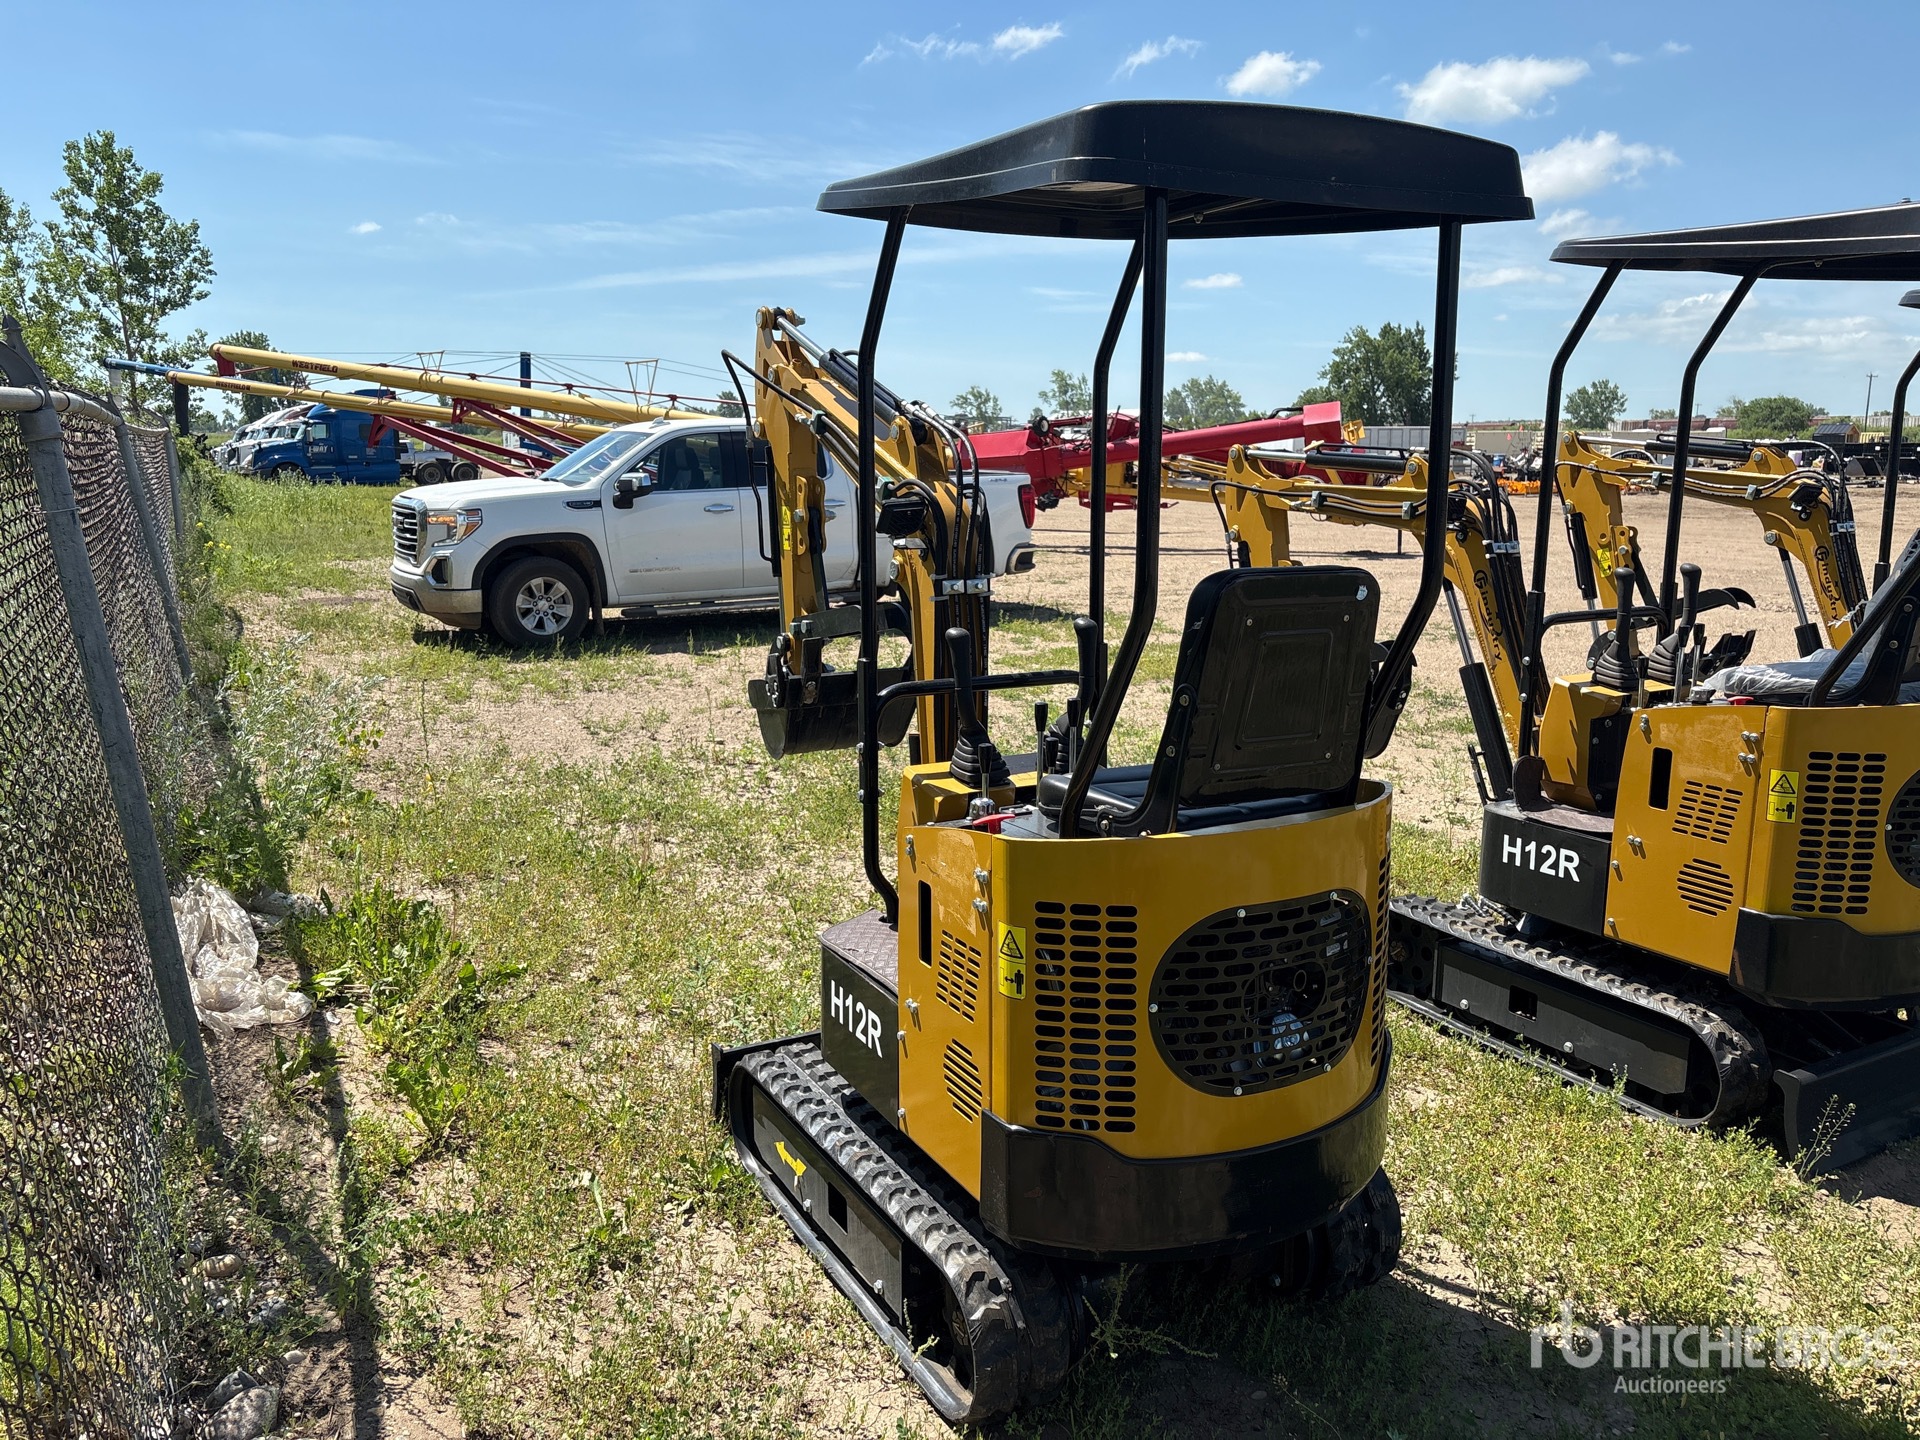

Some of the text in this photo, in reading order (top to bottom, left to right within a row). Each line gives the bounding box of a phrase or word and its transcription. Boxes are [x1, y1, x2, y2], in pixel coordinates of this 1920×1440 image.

[292, 360, 338, 373] WESTFIELD
[215, 380, 246, 391] WESTFIELD
[1502, 833, 1580, 883] H12R
[831, 979, 883, 1058] H12R
